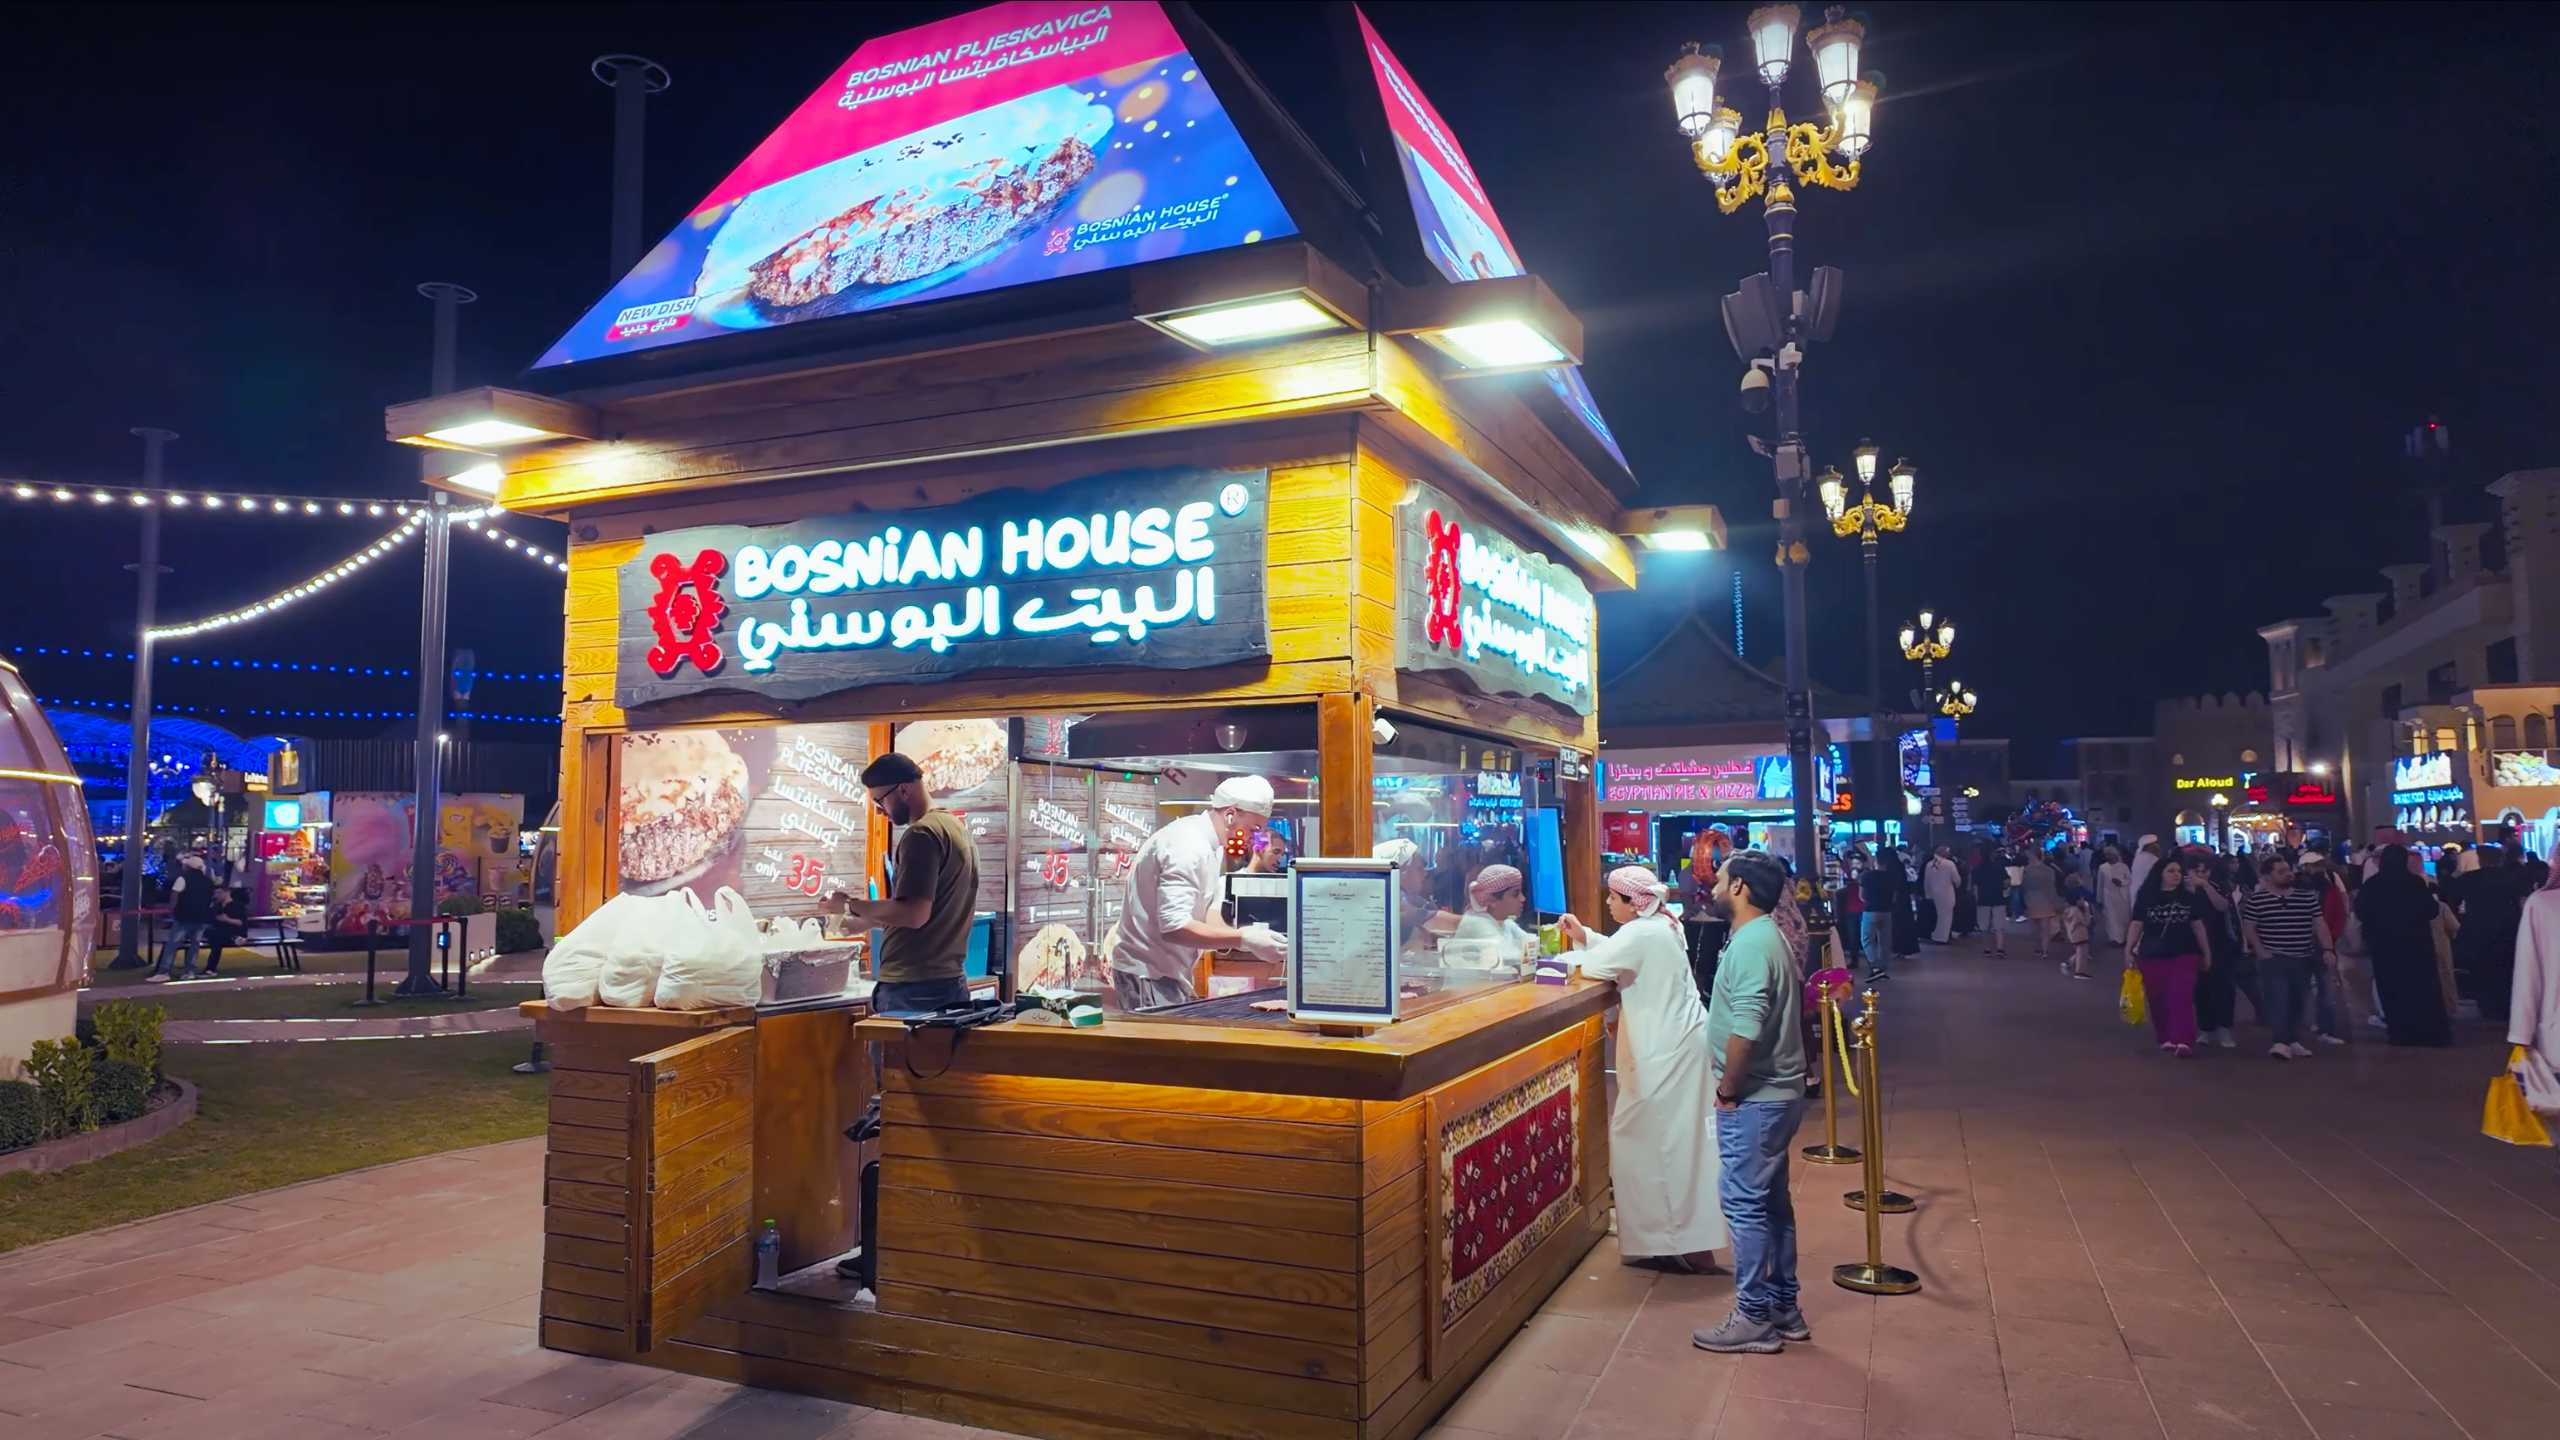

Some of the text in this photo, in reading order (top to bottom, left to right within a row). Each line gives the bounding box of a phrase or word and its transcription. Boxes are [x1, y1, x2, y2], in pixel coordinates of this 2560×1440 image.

[846, 5, 1113, 88] BOSNIAN PLJESKAVICA
[838, 72, 932, 110] البوسنية
[1159, 198, 1222, 219] HOUSE
[620, 299, 696, 321] NEW DISH
[1002, 501, 1215, 576] HOUSE
[737, 566, 1216, 671] البيت البوسني
[795, 735, 860, 784] BOSNIAN
[1608, 783, 1755, 801] EGYPTIAN PIE & PIZZA
[2176, 778, 2196, 790] Dar
[755, 862, 782, 882] only
[784, 853, 827, 896] 35
[1042, 848, 1070, 888] 35
